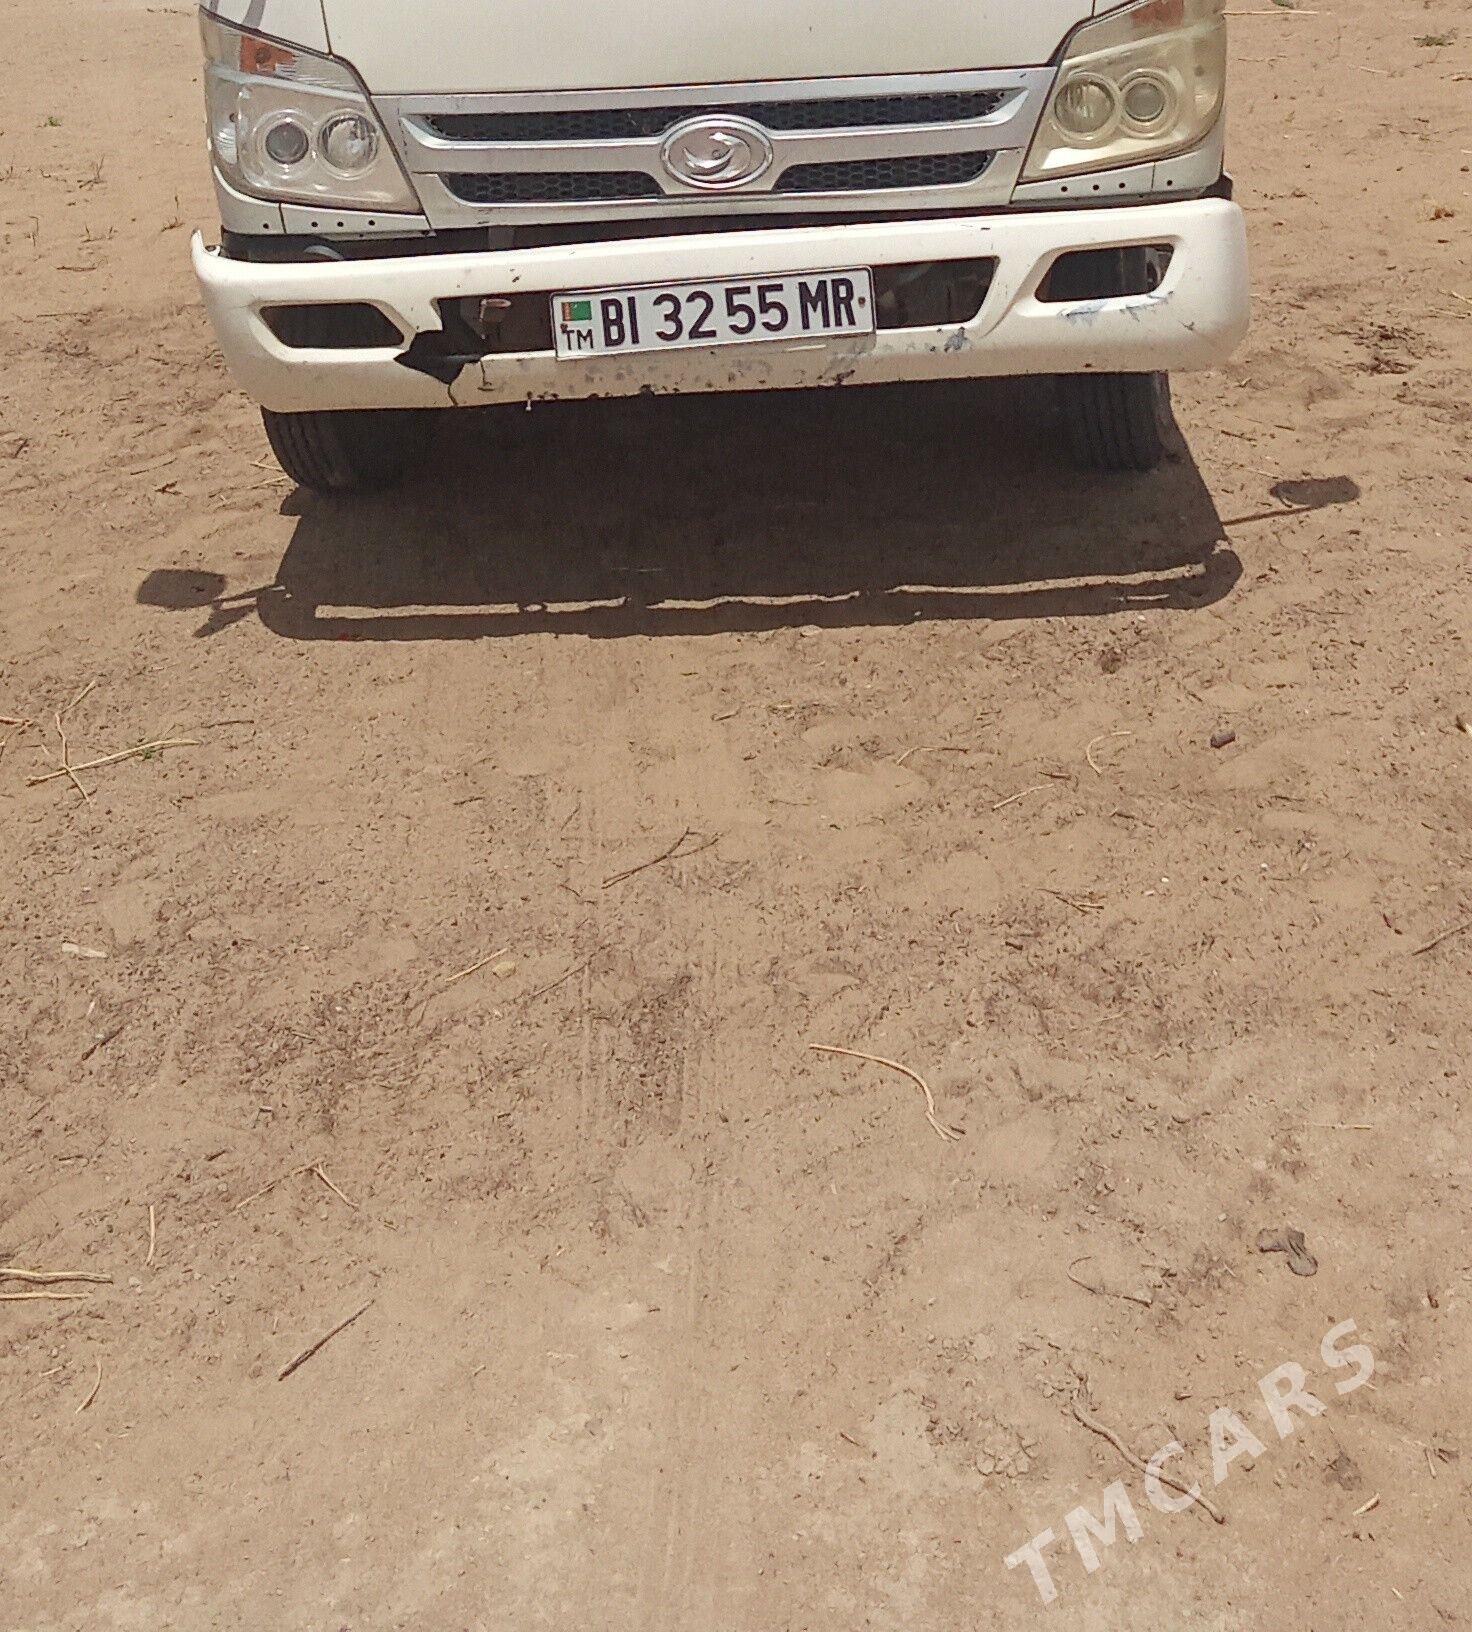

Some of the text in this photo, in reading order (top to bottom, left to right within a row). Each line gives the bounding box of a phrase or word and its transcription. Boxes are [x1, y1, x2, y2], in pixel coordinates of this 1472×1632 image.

[600, 296, 640, 347] BI
[798, 277, 857, 330] MR
[563, 328, 594, 351] TM
